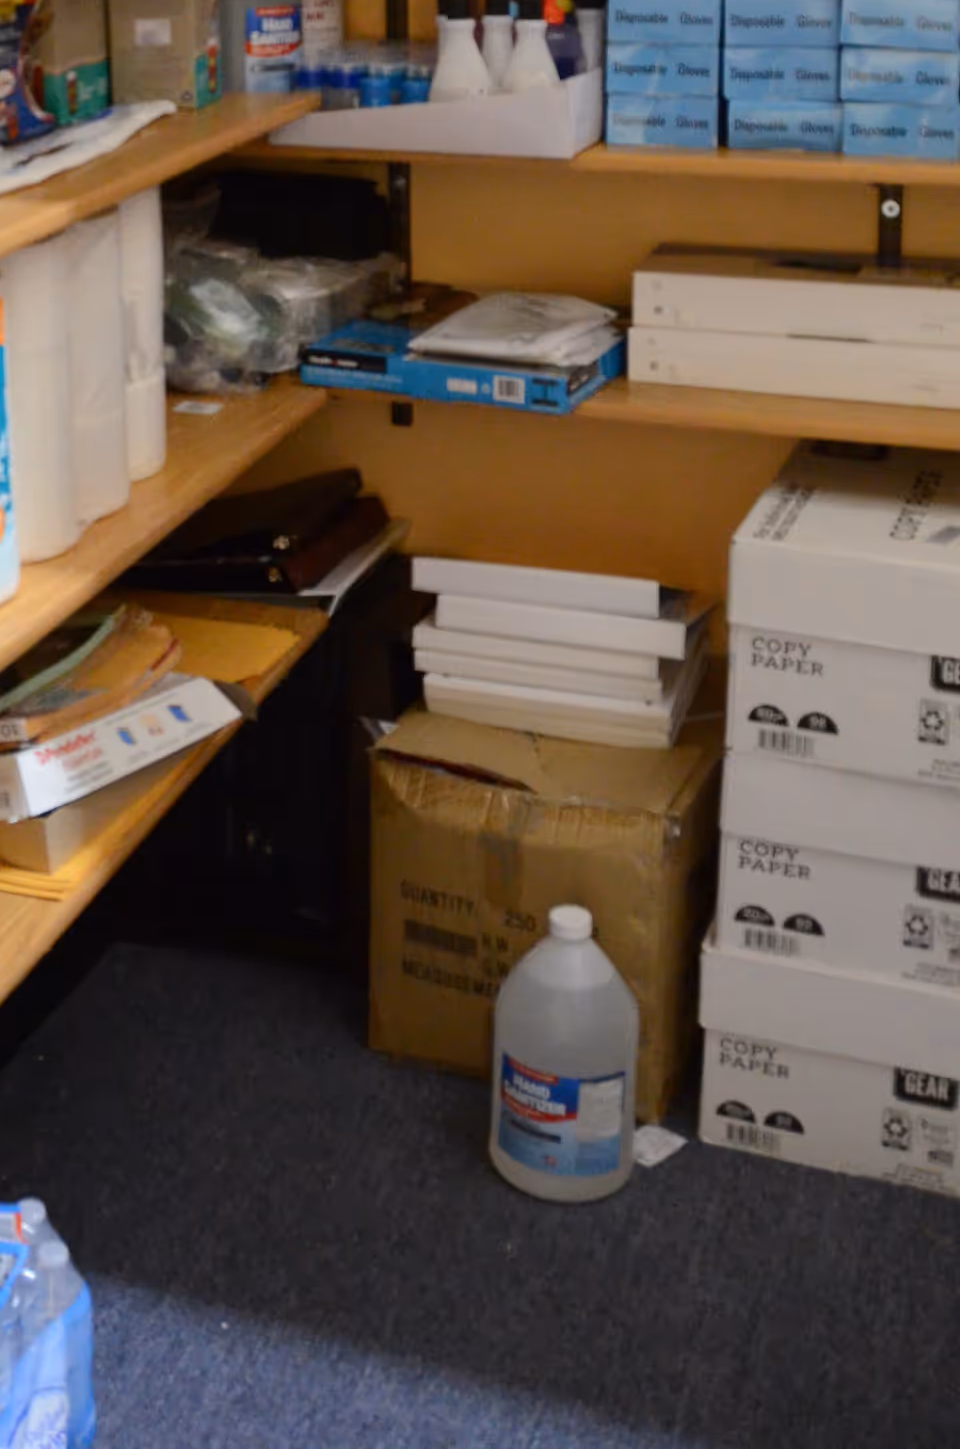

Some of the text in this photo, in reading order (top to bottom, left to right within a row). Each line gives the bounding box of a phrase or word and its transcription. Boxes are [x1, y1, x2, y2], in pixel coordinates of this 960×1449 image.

[615, 9, 713, 25] Disposable Gloves
[751, 635, 813, 659] COPY
[750, 653, 825, 677] PAPER
[739, 837, 799, 861] COPY
[737, 854, 813, 881] PAPER
[719, 1037, 778, 1061] COPY
[718, 1052, 791, 1081] PAPER
